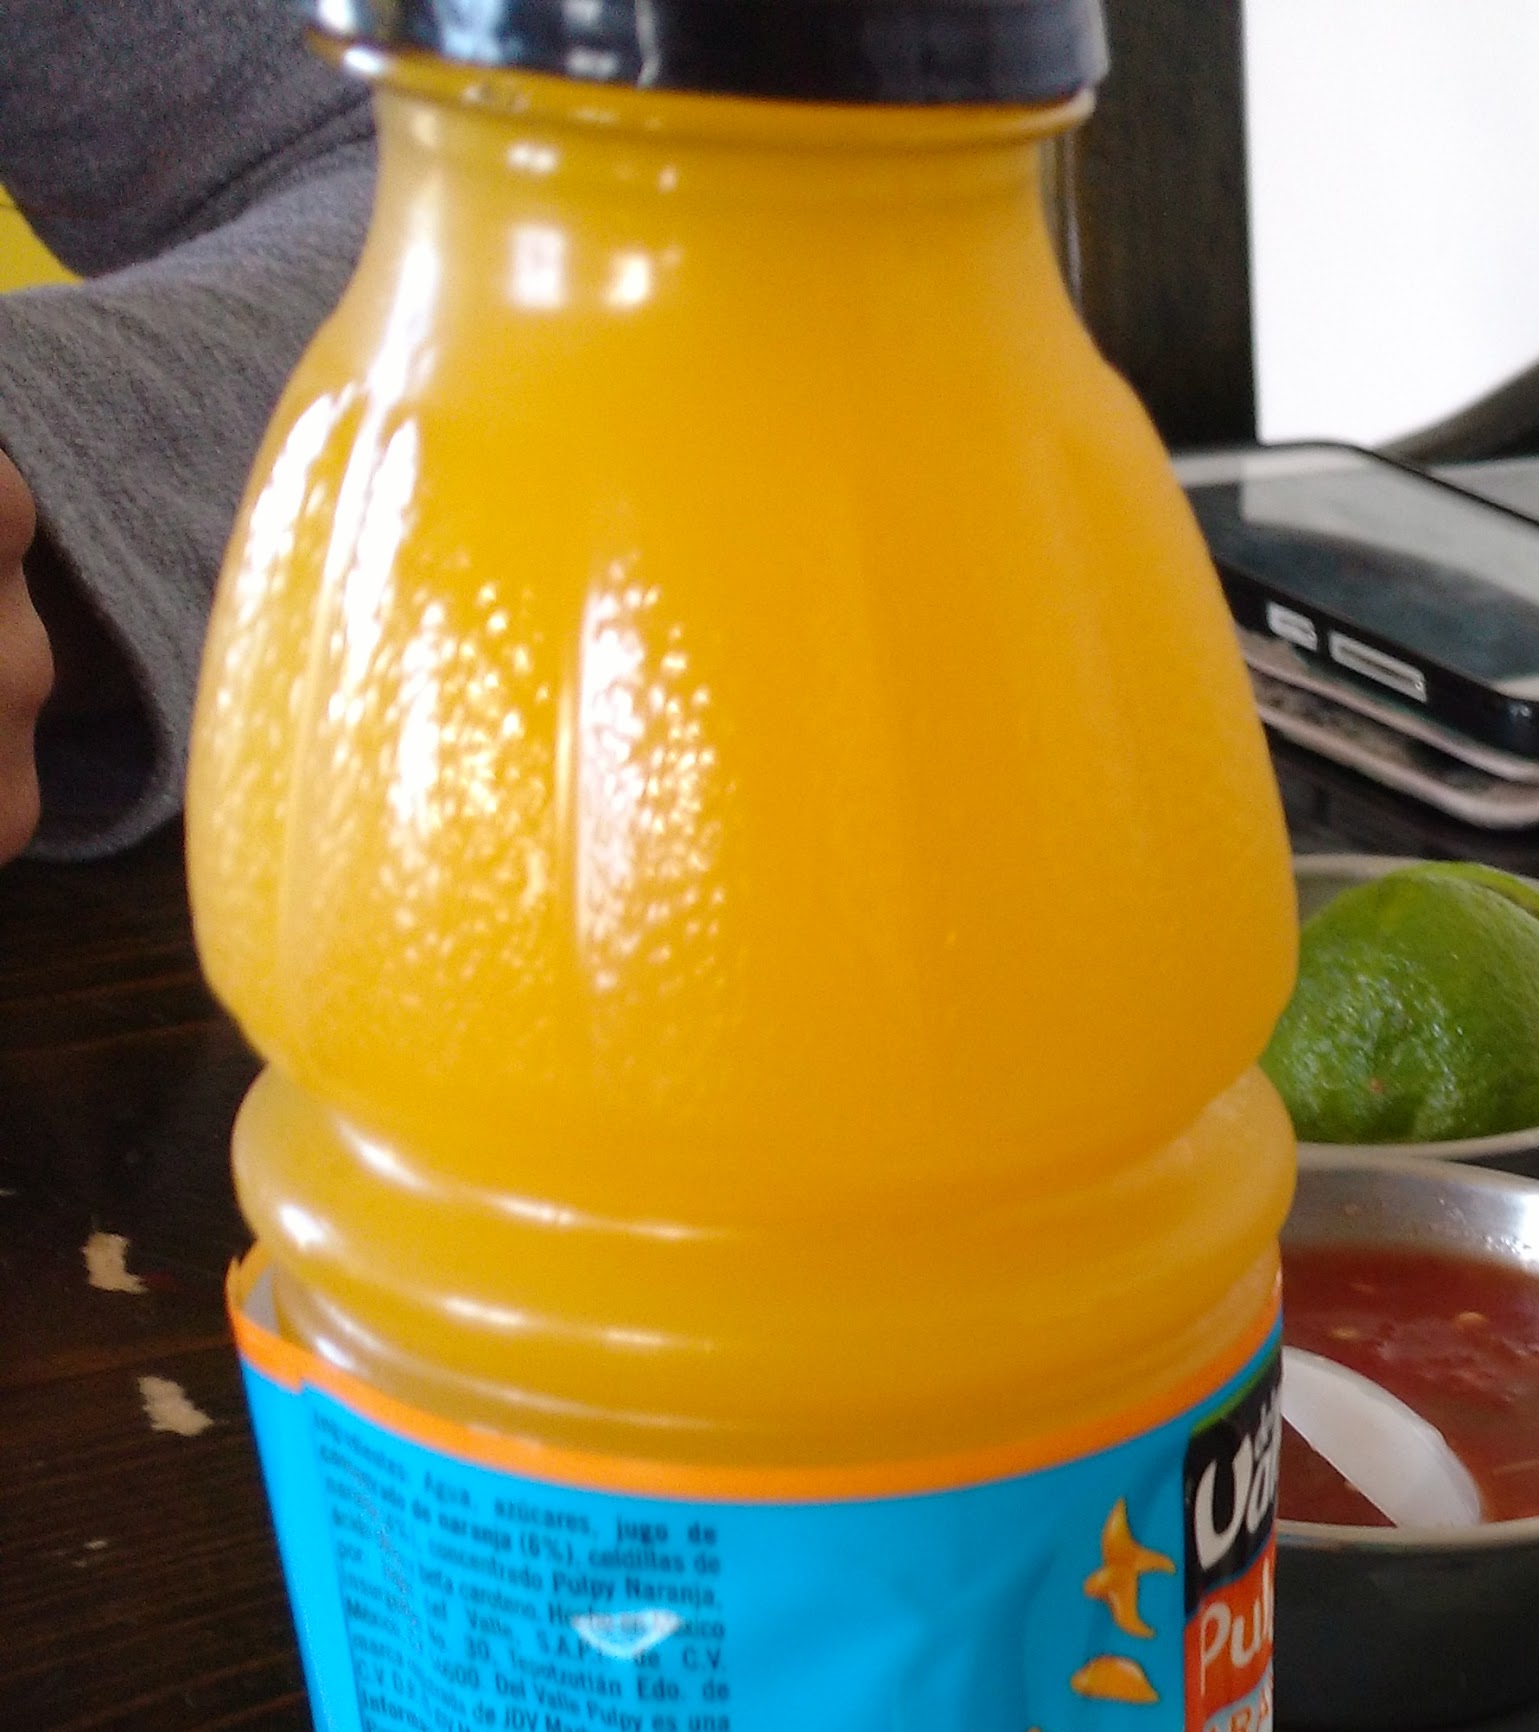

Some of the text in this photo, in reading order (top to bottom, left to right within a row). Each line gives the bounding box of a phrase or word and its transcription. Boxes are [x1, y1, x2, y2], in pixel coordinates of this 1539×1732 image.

[438, 1512, 512, 1553] naranja
[694, 1551, 721, 1576] de
[615, 1514, 669, 1547] jugo
[687, 1519, 717, 1545] de
[552, 1568, 615, 1602] Pulpy
[682, 1645, 725, 1671] C.V.
[494, 1672, 526, 1702] Del
[702, 1676, 730, 1702] de
[472, 1700, 496, 1726] de
